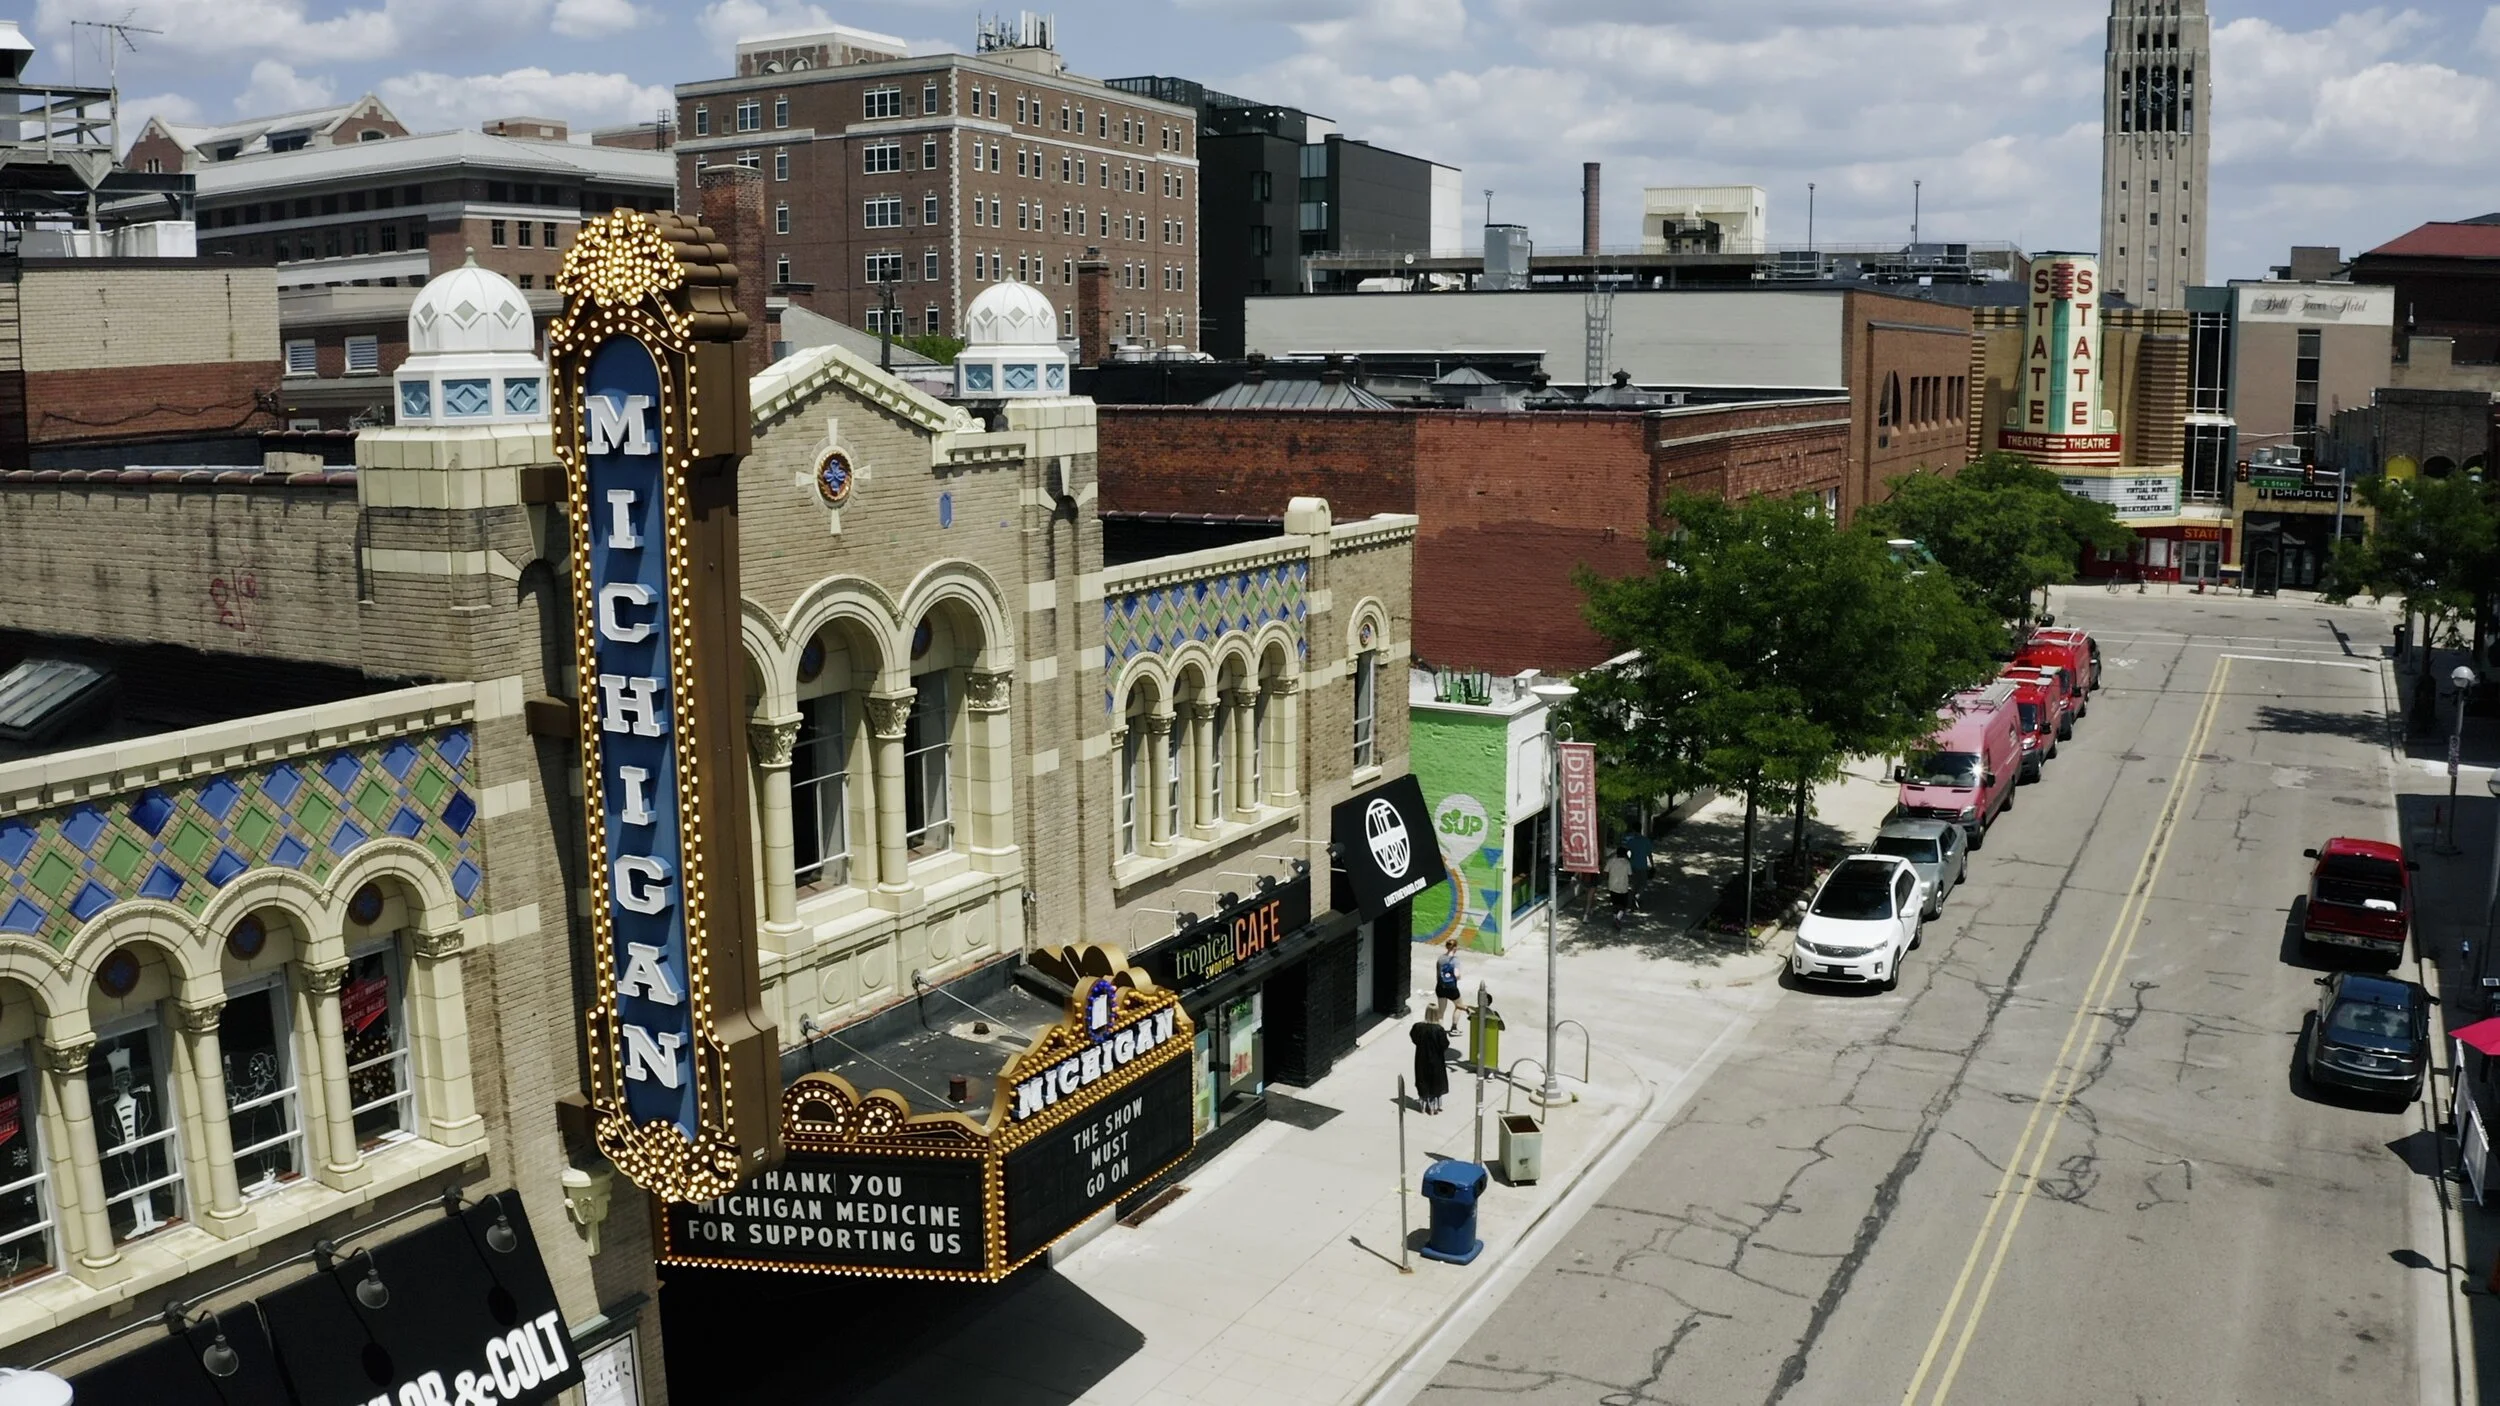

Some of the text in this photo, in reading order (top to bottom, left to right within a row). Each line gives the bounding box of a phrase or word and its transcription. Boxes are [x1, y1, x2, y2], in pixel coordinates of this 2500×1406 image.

[2259, 292, 2288, 311] Bell
[2030, 269, 2049, 424] STATE
[2072, 270, 2093, 425] STATE
[2007, 435, 2111, 449] THEATRE THEATRE
[585, 394, 686, 1089] MICHIGAN
[1567, 756, 1588, 862] DISTRICT
[1176, 900, 1280, 980] tropical CAFE
[1205, 953, 1235, 979] SMOOTHIE
[1016, 1007, 1175, 1120] MICHIGAN
[1073, 1096, 1143, 1154] THE SHOW
[1091, 1131, 1129, 1170] MUST
[849, 1174, 902, 1197] YOU
[1086, 1156, 1129, 1198] GO ON
[698, 1196, 961, 1227] MICHIGAN MEDICINE
[688, 1220, 961, 1254] FOR SUPPORTING US
[486, 1309, 570, 1399] COLT
